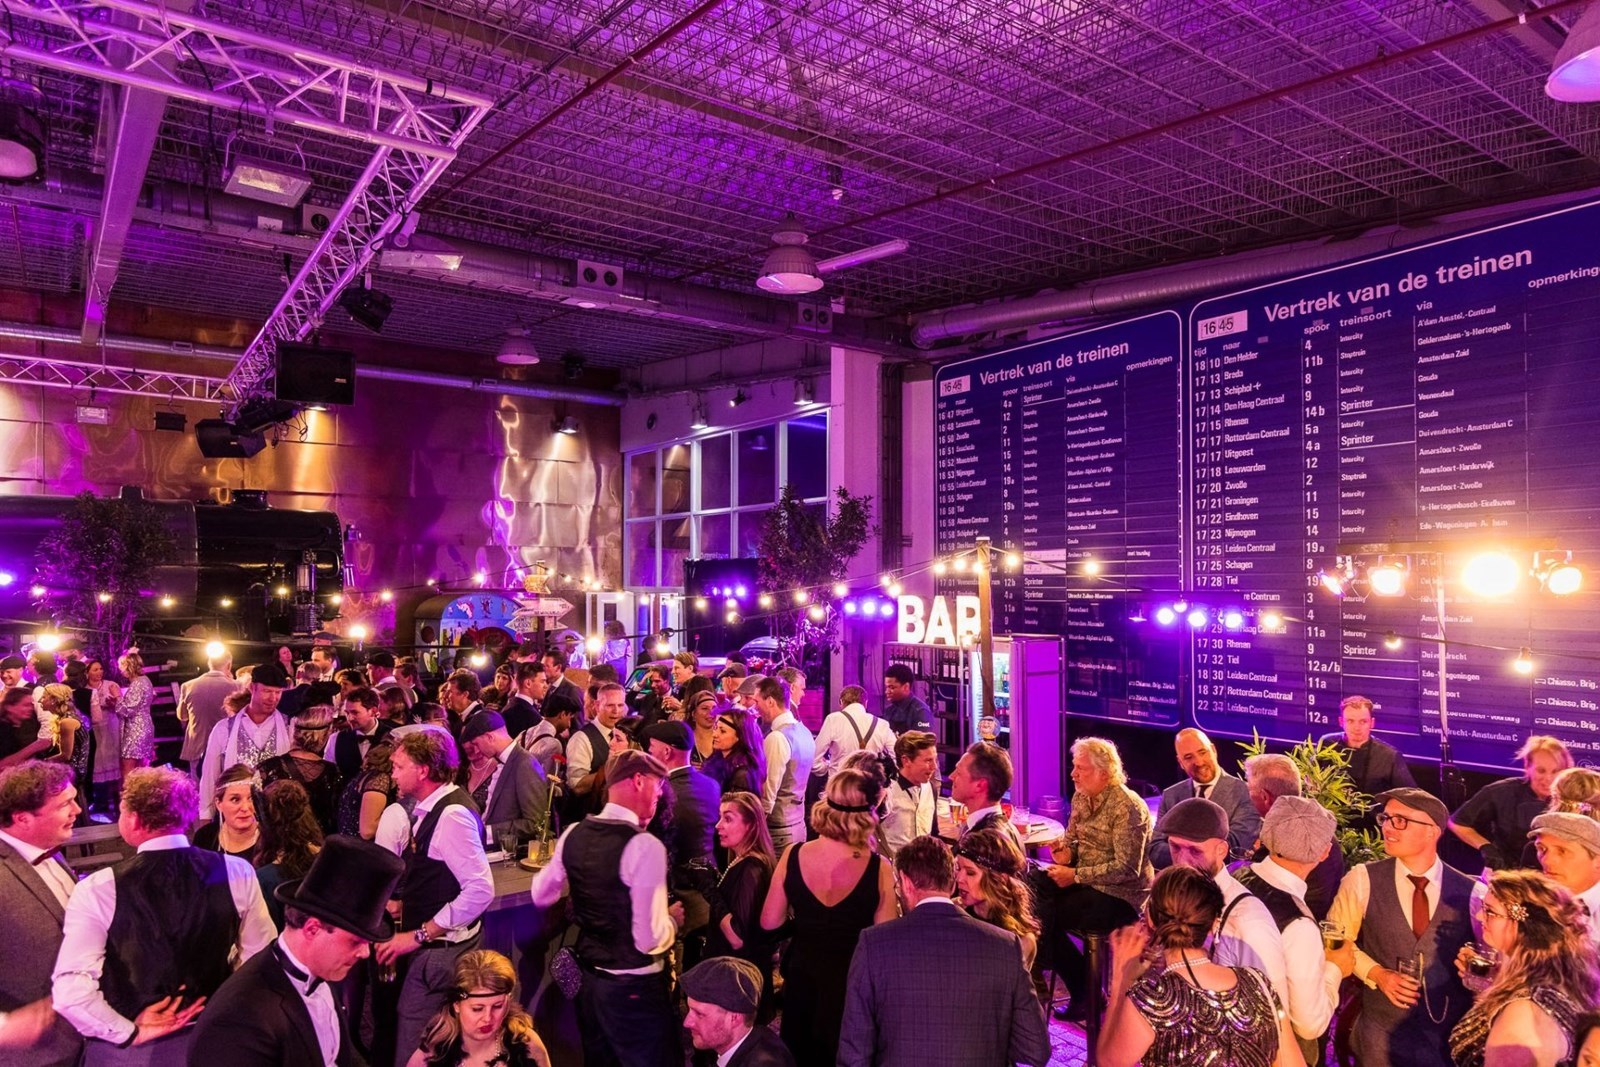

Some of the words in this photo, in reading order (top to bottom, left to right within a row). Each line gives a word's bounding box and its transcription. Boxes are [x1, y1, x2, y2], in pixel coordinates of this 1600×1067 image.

[1528, 266, 1600, 288] opmerking
[1264, 291, 1341, 322] Vertrek
[1348, 282, 1390, 304] van
[1398, 272, 1428, 293] de
[1436, 250, 1532, 284] treinen
[1416, 301, 1433, 311] via
[1340, 309, 1392, 327] treinsoort
[1203, 322, 1216, 335] 16
[1219, 316, 1233, 330] 45
[1304, 323, 1330, 335] spoor
[1222, 342, 1240, 351] naar
[1304, 340, 1312, 350] 4
[1194, 347, 1206, 357] tijd
[980, 365, 1024, 385] Vertrek
[1028, 360, 1052, 375] van
[1056, 354, 1073, 369] de
[1077, 342, 1129, 364] treinen
[1126, 356, 1172, 372] opmerkingen
[1195, 361, 1206, 371] 18
[1210, 358, 1220, 368] 10
[1224, 356, 1236, 364] Den
[1304, 355, 1323, 367] 11b
[1418, 353, 1454, 364] Amsterdam
[1195, 376, 1206, 386] 17
[1210, 374, 1220, 384] 13
[1224, 370, 1243, 380] Breda
[1305, 374, 1312, 384] 8
[1418, 374, 1438, 382] Gouda
[1195, 392, 1206, 402] 17
[1210, 389, 1220, 400] 13
[1224, 383, 1252, 396] Schiphol
[1305, 390, 1312, 401] 9
[1195, 407, 1206, 417] 17
[1210, 405, 1220, 415] 14
[1224, 402, 1237, 411] Den
[1238, 400, 1255, 409] Haag
[1256, 394, 1284, 407] Centraal
[1340, 400, 1373, 411] Sprinter
[1003, 413, 1010, 421] 12
[1419, 410, 1439, 419] Gouda
[1003, 426, 1007, 434] 2
[1196, 422, 1206, 433] 17
[1210, 420, 1221, 431] 15
[1224, 418, 1248, 427] Rhenen
[1003, 438, 1010, 446] 11
[1196, 438, 1206, 448] 17
[1210, 436, 1221, 446] 17
[1224, 432, 1260, 443] Rotterdam
[1260, 427, 1290, 438] Centraal
[1341, 435, 1374, 446] Sprinter
[1004, 451, 1011, 459] 15
[1196, 453, 1206, 463] 17
[1210, 452, 1221, 462] 17
[1004, 464, 1011, 472] 14
[1306, 457, 1318, 468] 12
[1196, 469, 1206, 479] 17
[1210, 467, 1221, 477] 18
[1224, 463, 1266, 474] Leeuwarden
[1306, 475, 1313, 485] 2
[1196, 484, 1206, 494] 17
[1210, 483, 1221, 493] 20
[1225, 481, 1247, 490] Zwolle
[1004, 489, 1008, 498] 8
[1306, 491, 1317, 502] 11
[1196, 500, 1206, 509] 17
[1210, 499, 1221, 509] 21
[1225, 496, 1258, 506] Groningen
[1004, 515, 1008, 523] 3
[1196, 515, 1206, 524] 17
[1210, 514, 1221, 524] 22
[1225, 512, 1258, 521] Eindhoven
[1306, 508, 1319, 519] 15
[1196, 530, 1206, 540] 17
[1210, 530, 1221, 540] 23
[1306, 525, 1319, 536] 14
[1196, 546, 1206, 556] 17
[1210, 545, 1221, 555] 25
[1225, 544, 1246, 552] Leiden
[1247, 543, 1275, 552] Centraal
[1196, 561, 1206, 571] 17
[1210, 561, 1221, 571] 25
[1225, 560, 1253, 570] Schagen
[1306, 559, 1313, 569] 8
[1024, 578, 1043, 586] Sprinter
[1196, 577, 1207, 587] 17
[1210, 577, 1222, 587] 28
[1226, 576, 1238, 585] Tiel
[1251, 592, 1280, 600] Centrum
[1307, 593, 1313, 603] 3
[898, 595, 980, 645] BAR
[1307, 609, 1314, 620] 4
[1307, 626, 1326, 638] 11a
[1197, 639, 1208, 648] 17
[1212, 639, 1223, 649] 30
[1227, 639, 1251, 649] Rhenen
[1307, 643, 1314, 654] 9
[1344, 644, 1377, 656] Sprinter
[1197, 654, 1208, 663] 17
[1212, 655, 1223, 664] 32
[1227, 655, 1239, 664] Tiel
[1198, 670, 1208, 679] 18
[1212, 670, 1223, 680] 30
[1227, 671, 1248, 680] Leiden
[1249, 672, 1278, 682] Centraal
[1308, 678, 1326, 689] 11a
[1198, 685, 1208, 695] 18
[1212, 686, 1224, 695] 37
[1228, 686, 1262, 698] Rotterdam
[1264, 690, 1293, 700] Centraal
[1308, 695, 1315, 705] 9
[1227, 703, 1248, 713] Leiden
[1249, 705, 1278, 716] Centraal
